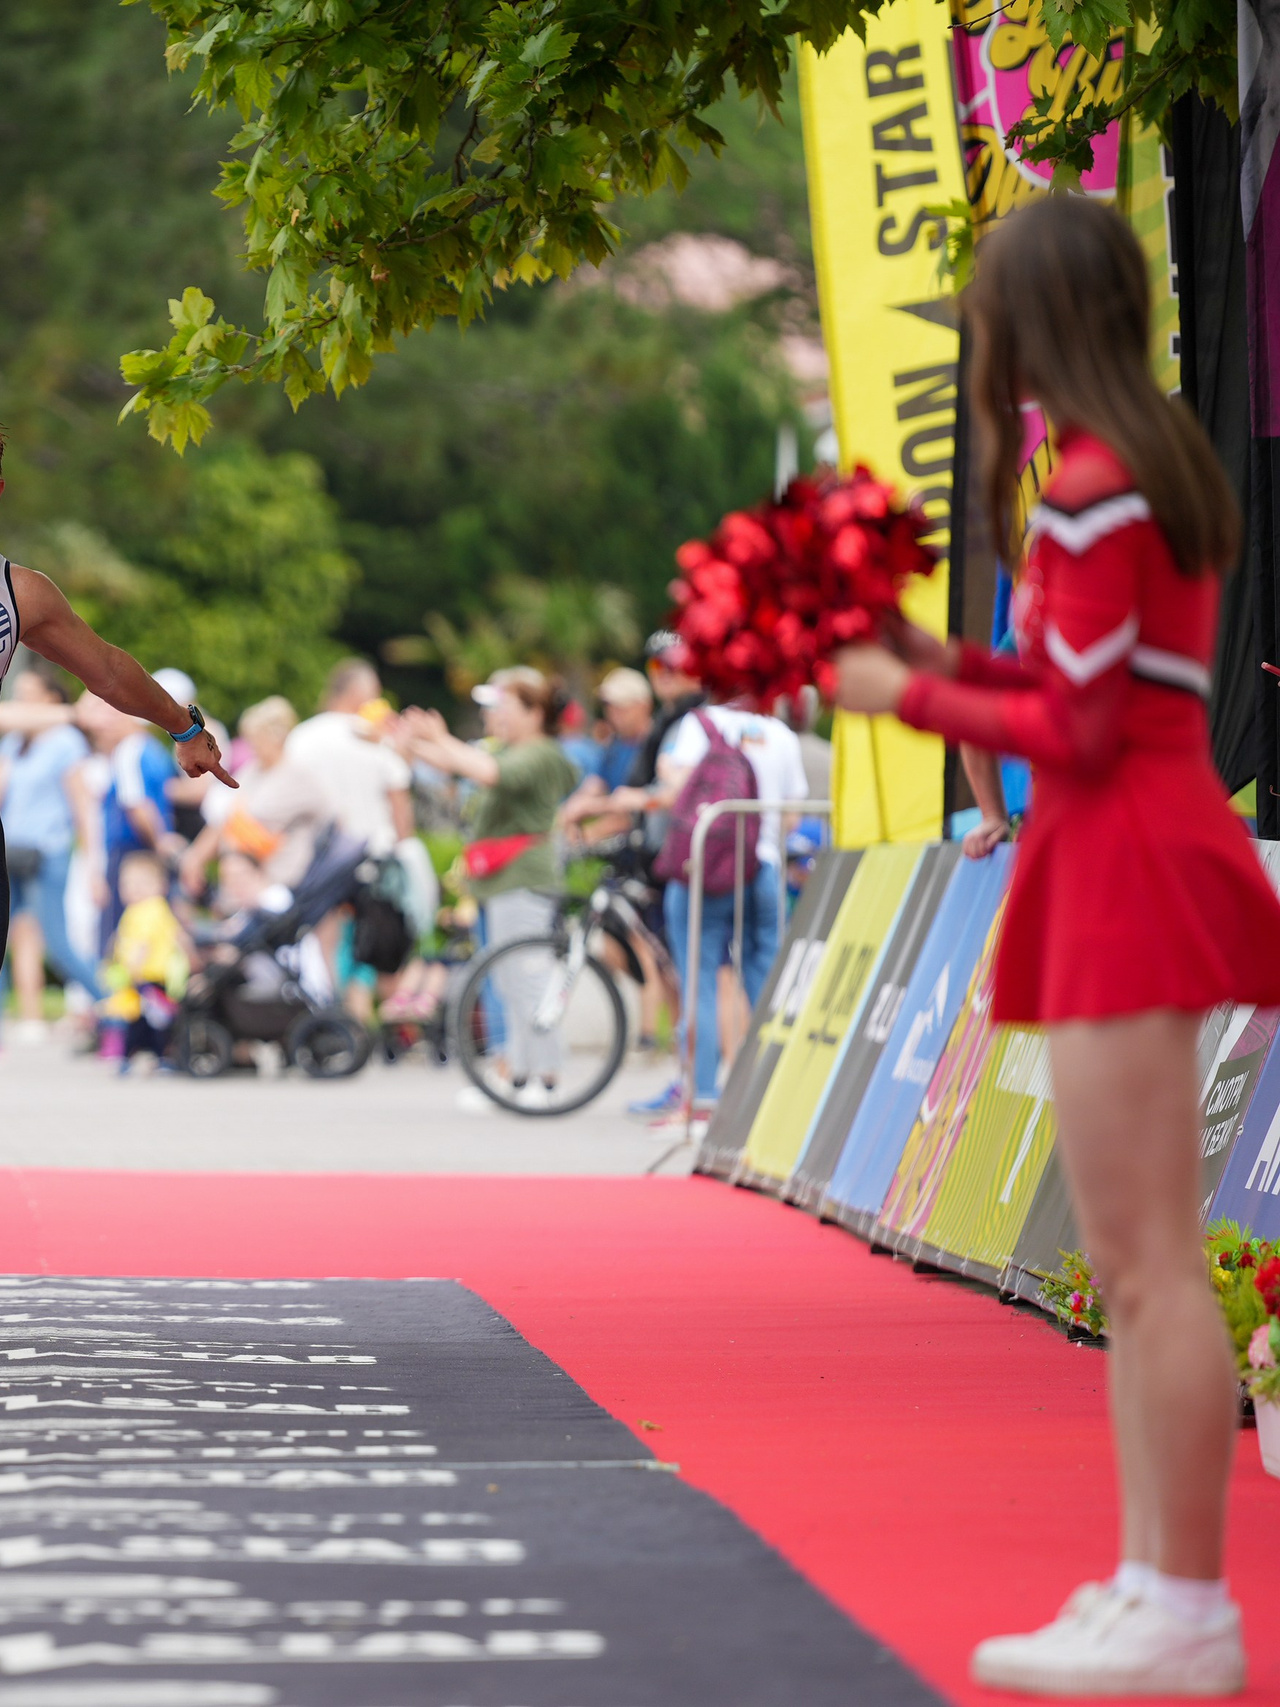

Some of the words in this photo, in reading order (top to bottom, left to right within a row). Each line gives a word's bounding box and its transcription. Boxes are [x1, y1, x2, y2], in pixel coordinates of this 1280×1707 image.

[867, 41, 946, 257] STAR
[91, 1350, 378, 1364] STAR
[100, 1396, 410, 1413] STAR
